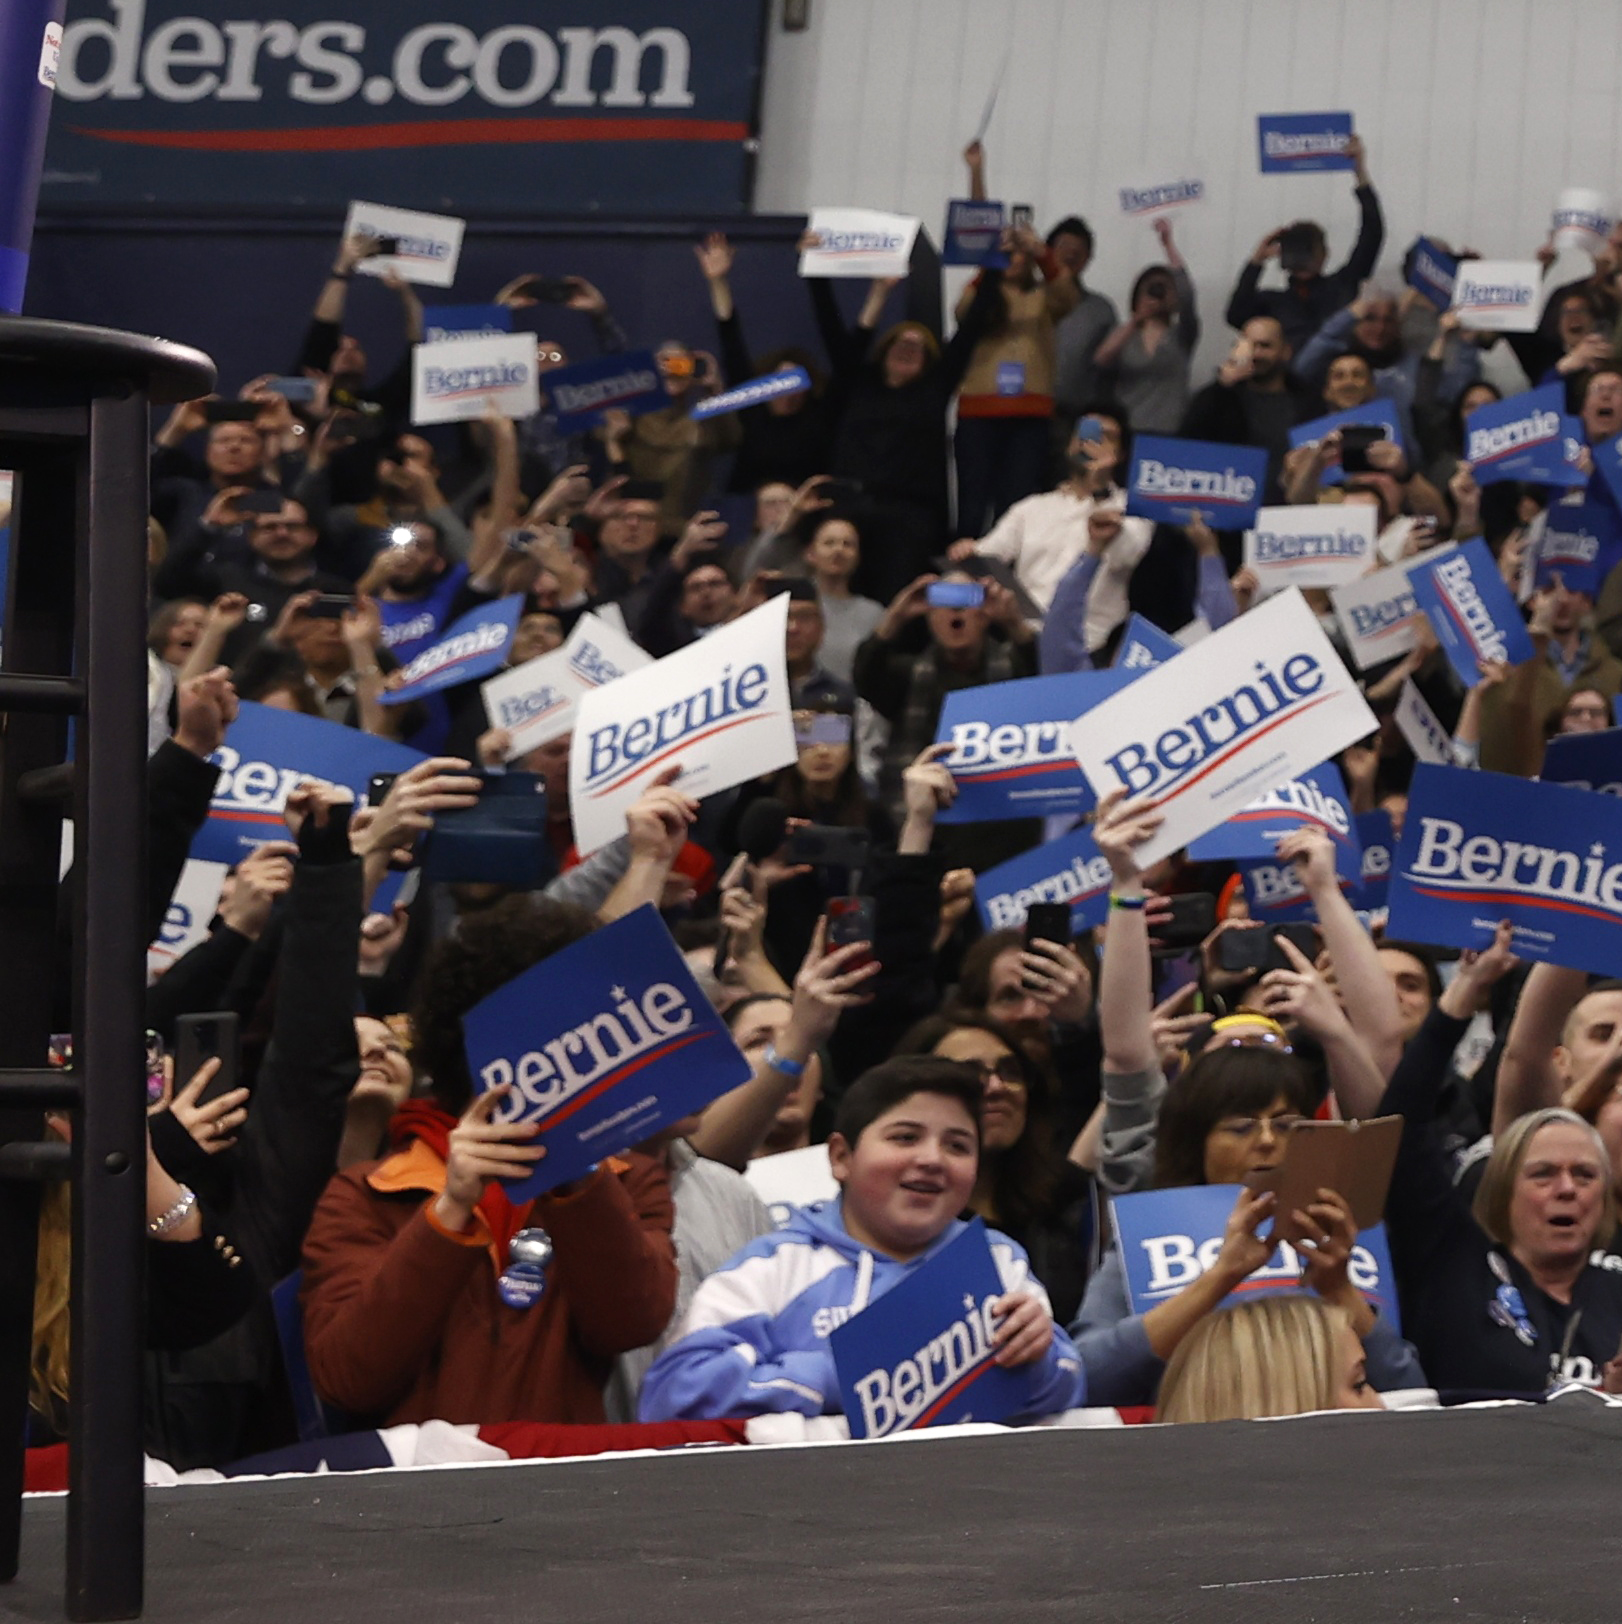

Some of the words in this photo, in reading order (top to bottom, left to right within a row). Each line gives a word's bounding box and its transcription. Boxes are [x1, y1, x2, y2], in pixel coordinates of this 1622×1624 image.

[1139, 457, 1257, 503] Bernie
[1467, 408, 1562, 464] Bernie
[1253, 528, 1367, 560] Bernie
[1433, 553, 1510, 664] Bernie
[585, 661, 768, 780] Bernie
[1105, 653, 1325, 798] Bernie
[481, 982, 694, 1126] Bernie
[854, 1293, 1003, 1437] Bernie
